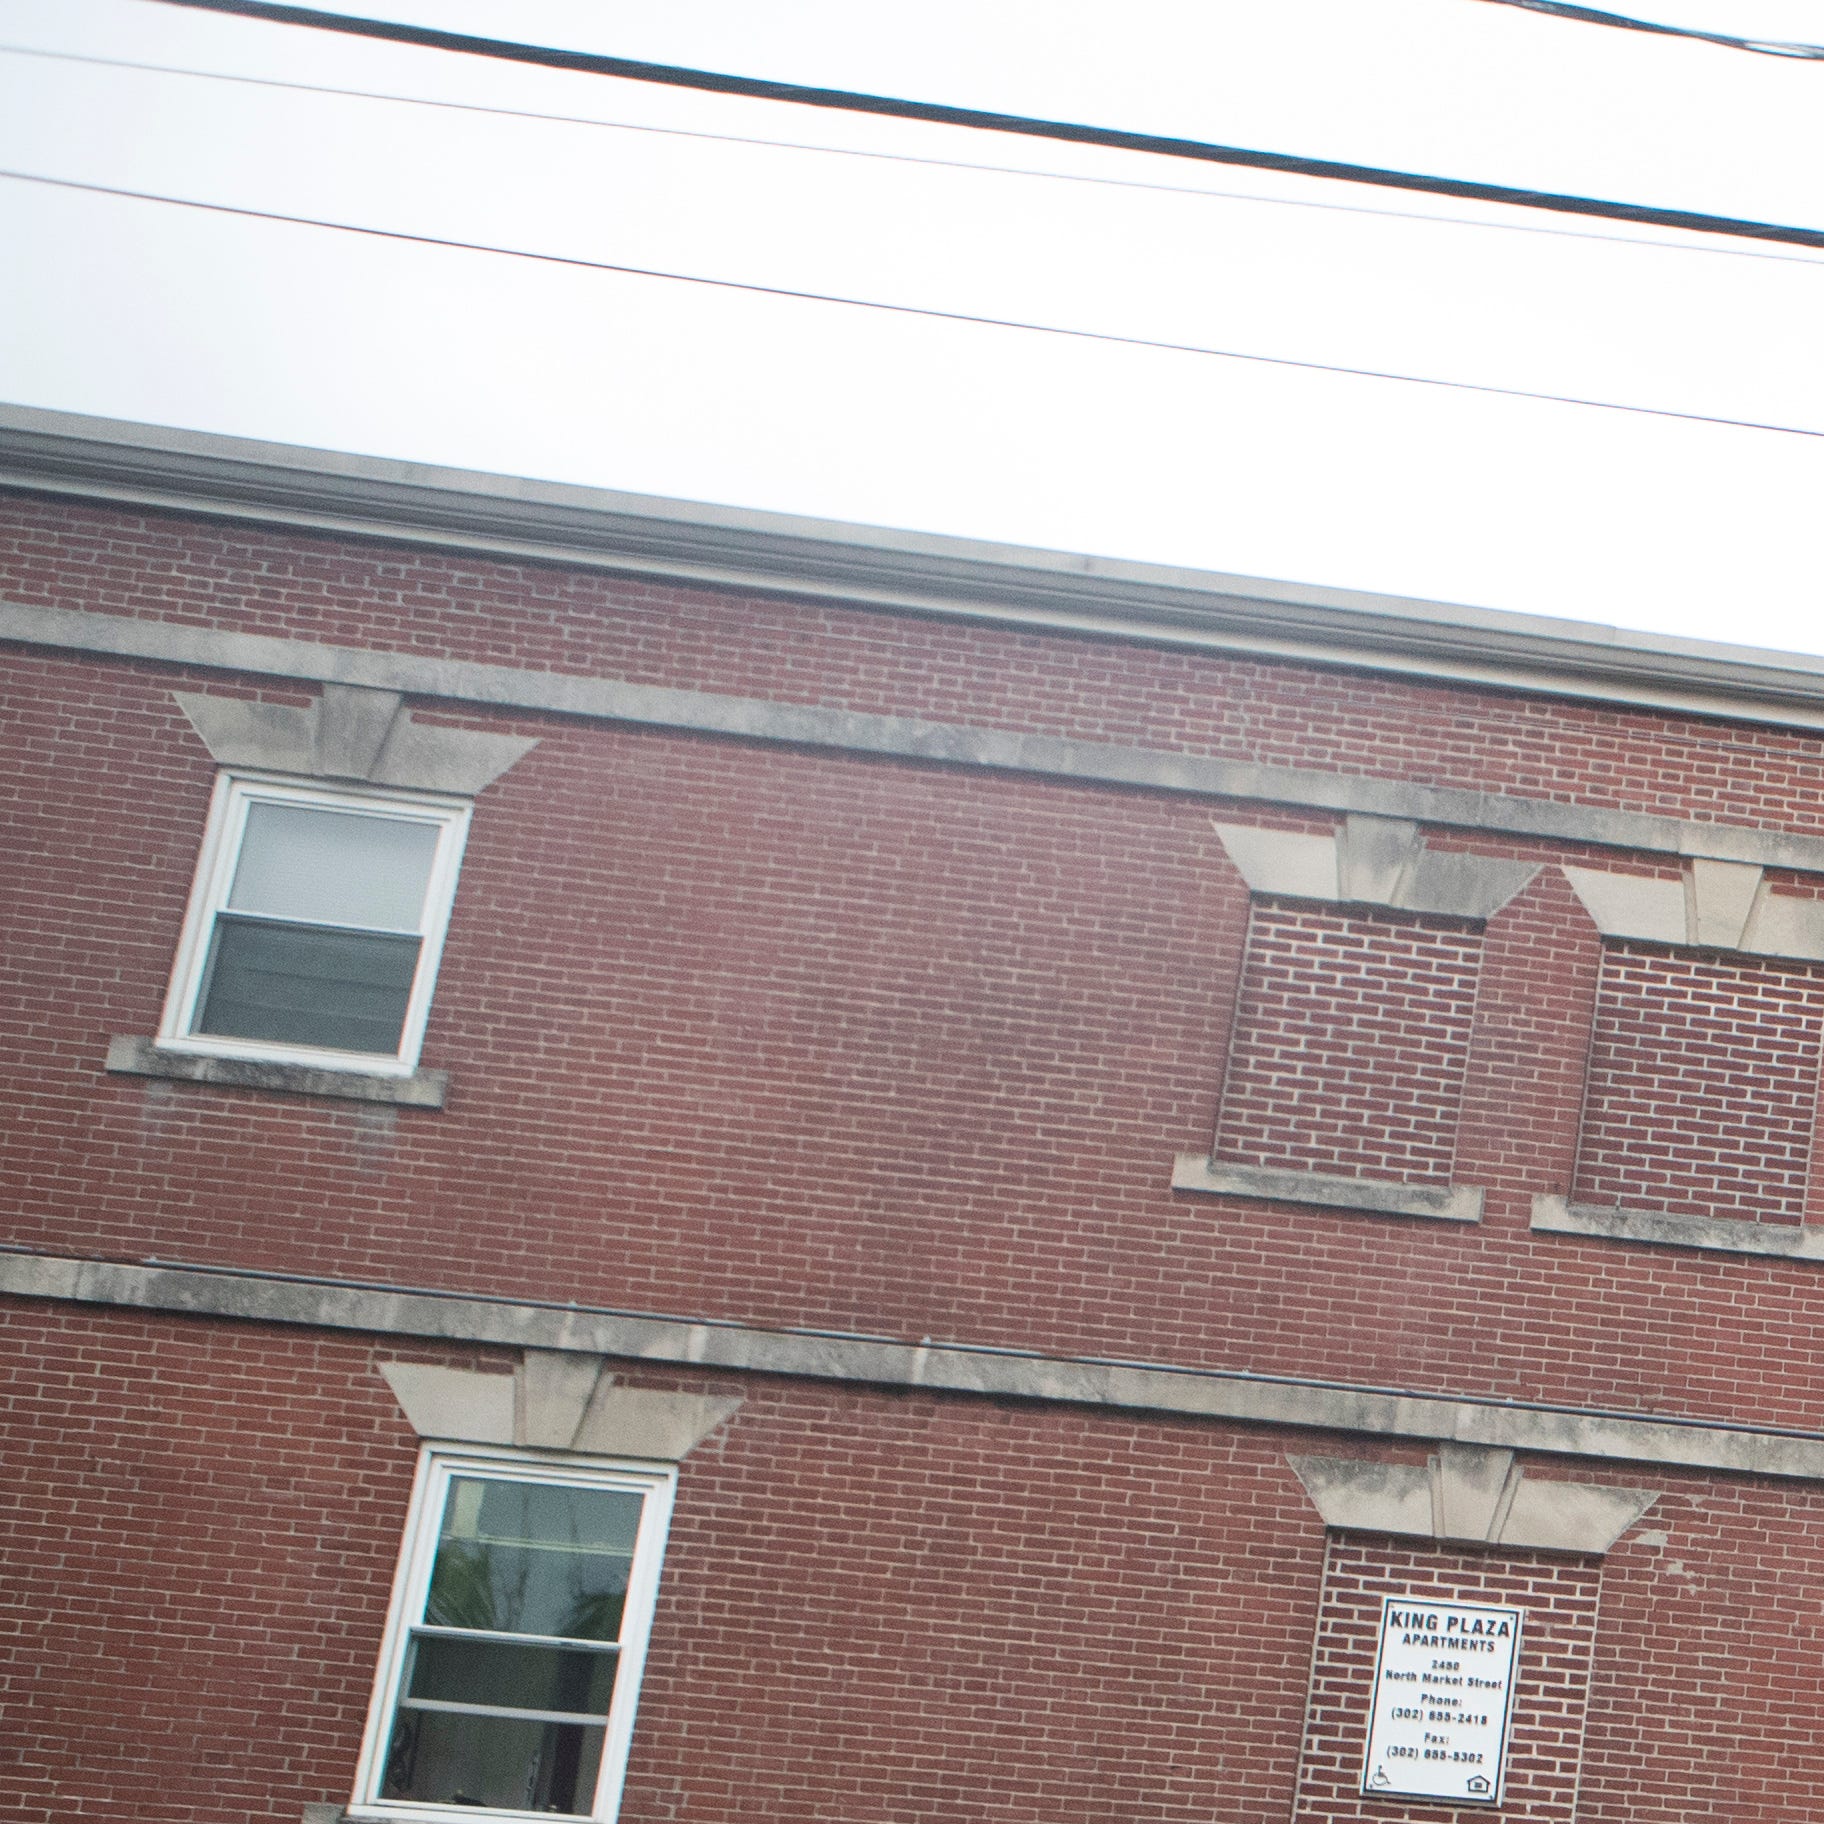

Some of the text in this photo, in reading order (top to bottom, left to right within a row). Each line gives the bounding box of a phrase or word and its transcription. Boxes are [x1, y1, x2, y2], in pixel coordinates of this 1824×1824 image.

[1390, 1610, 1510, 1638] KING PLAZA
[1402, 1633, 1496, 1653] APARTMENTS
[1385, 1669, 1503, 1690] North Market Street
[1421, 1693, 1463, 1707] Phone:
[1391, 1707, 1424, 1721] (302)
[1424, 1732, 1450, 1745] Fax:
[1386, 1745, 1419, 1760] (302)
